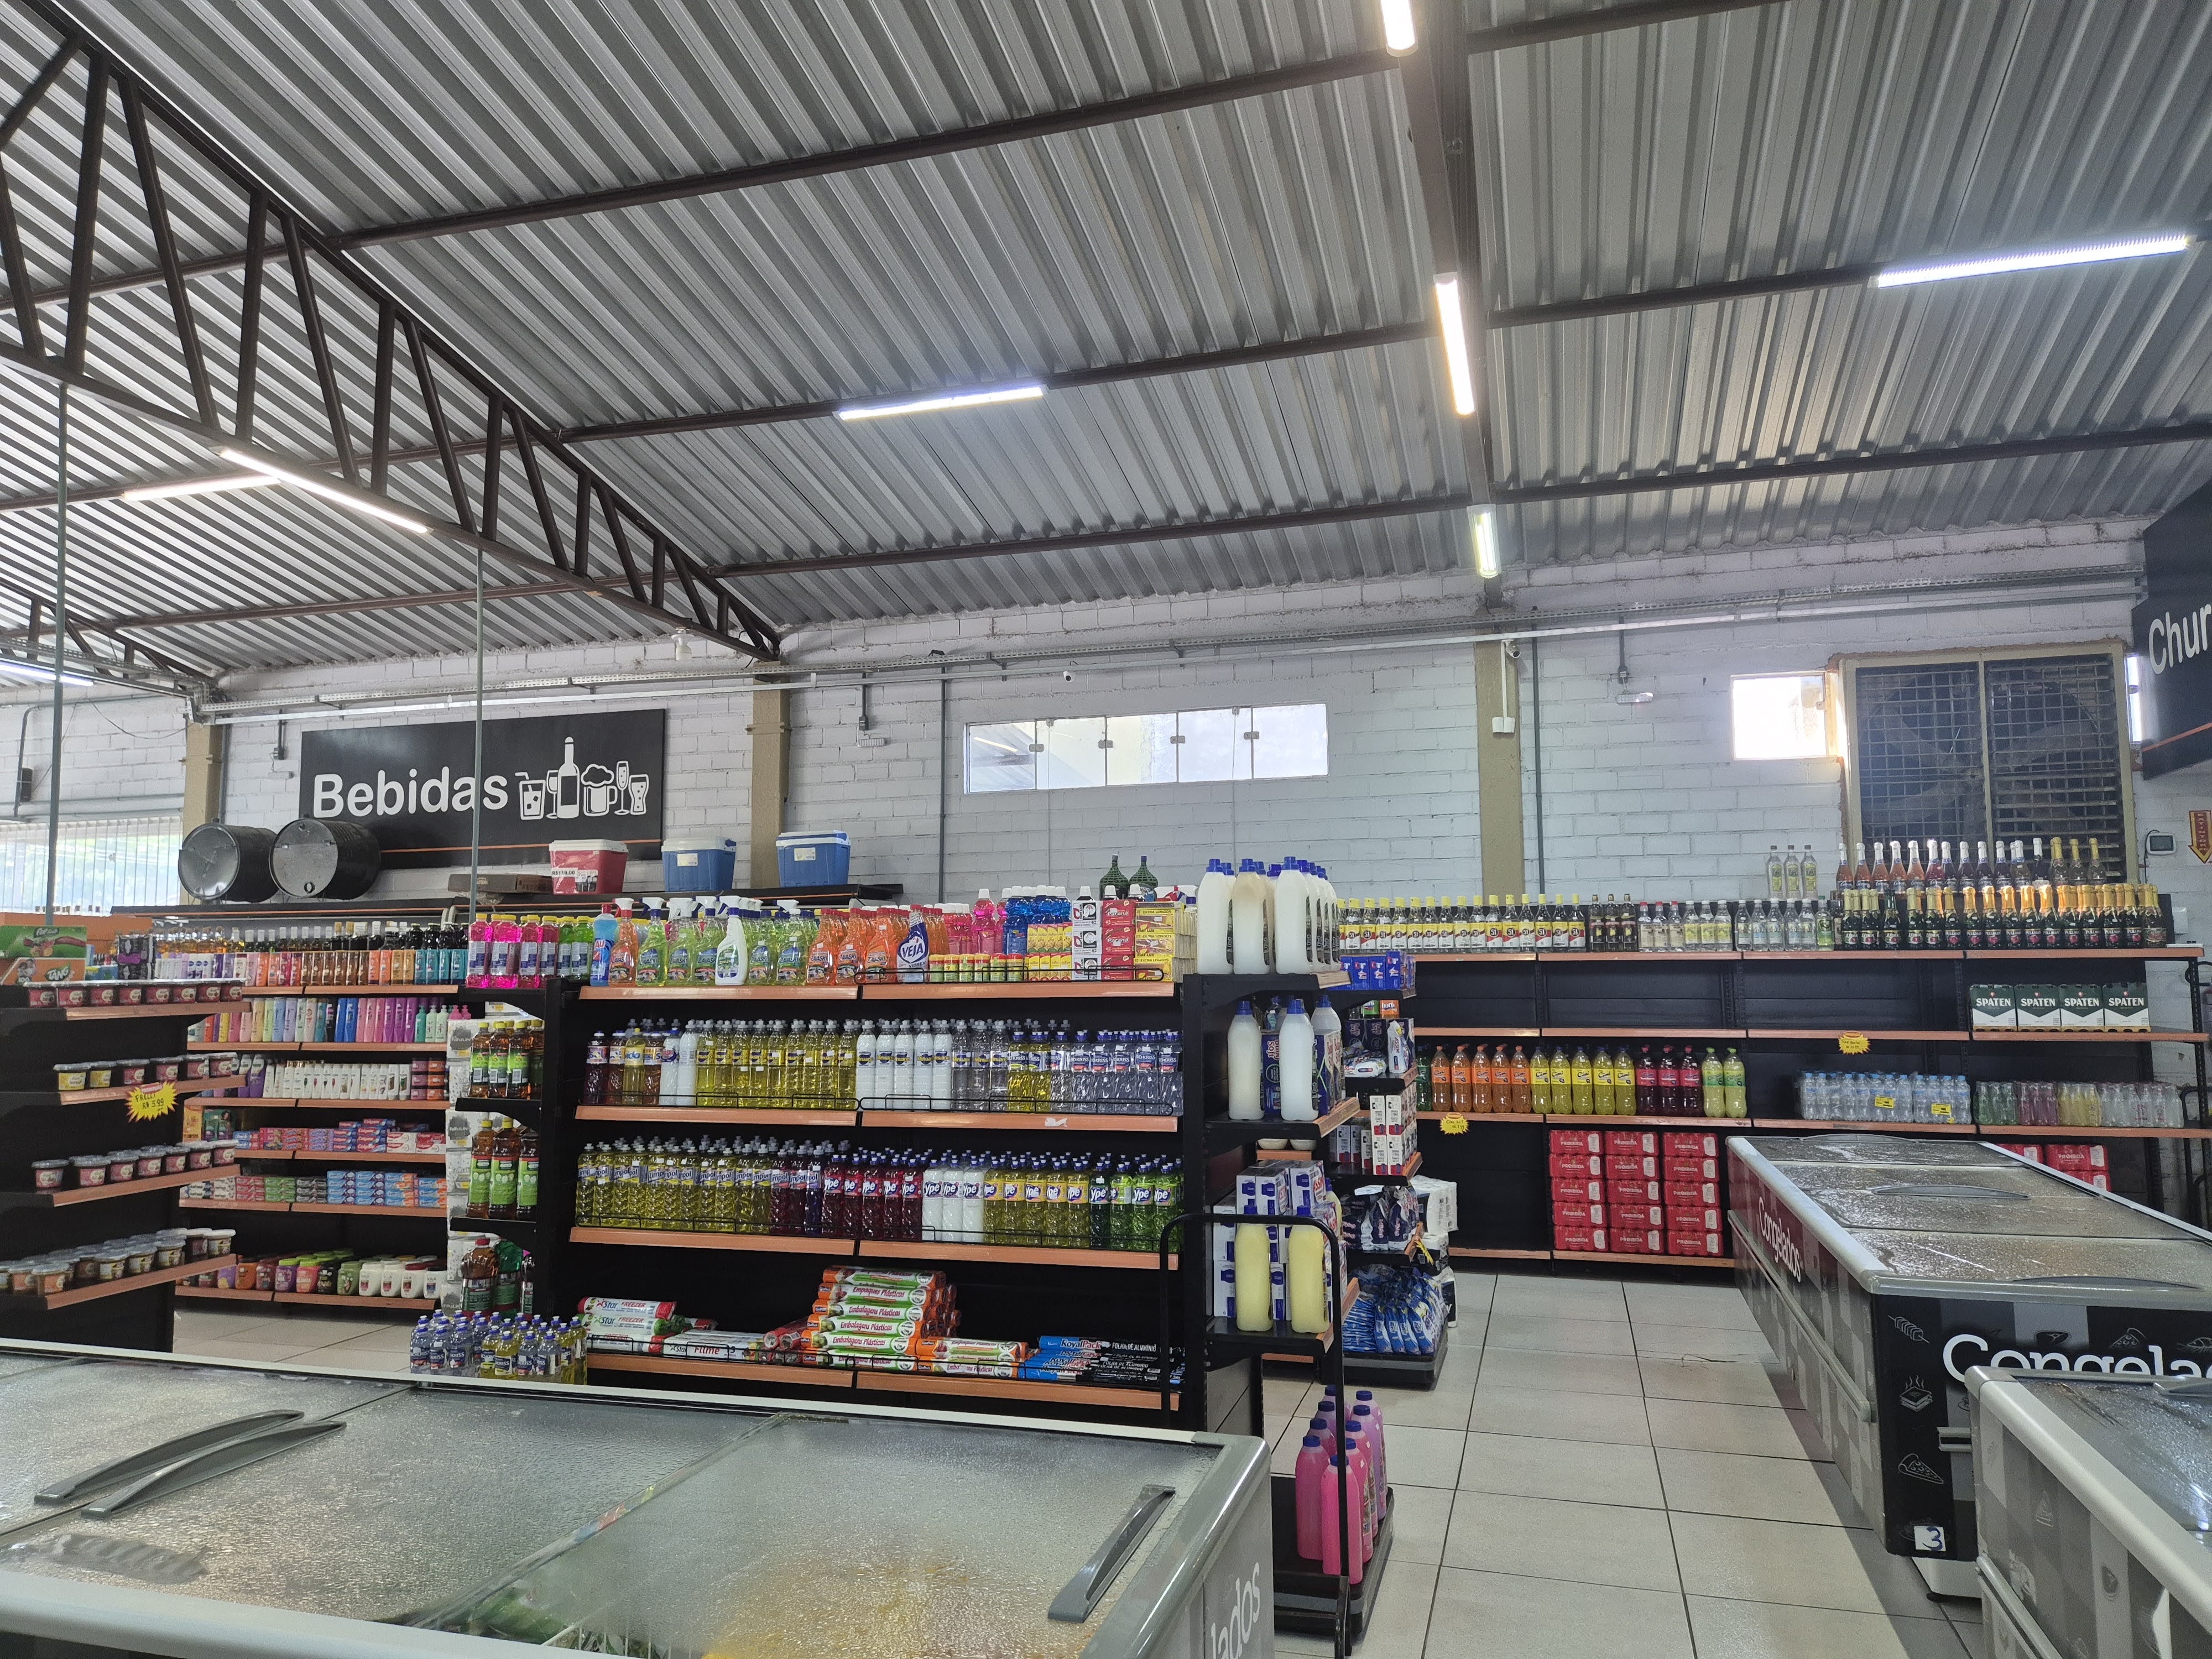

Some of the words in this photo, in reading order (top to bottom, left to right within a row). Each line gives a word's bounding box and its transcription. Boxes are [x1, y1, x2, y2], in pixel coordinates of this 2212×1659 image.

[2149, 604, 2211, 674] Chur
[314, 766, 508, 818] Bebidas
[901, 944, 924, 958] VEJA
[1976, 998, 2011, 1006] SPATEN
[2021, 998, 2056, 1006] SPATEN
[2064, 998, 2099, 1006] SPATEN
[2109, 998, 2144, 1006] SPATEN
[1759, 1197, 1801, 1283] Congelados
[853, 1287, 881, 1296] Empaques
[603, 1301, 618, 1309] Star
[849, 1306, 878, 1315] Embalagens
[841, 1322, 870, 1331] Embalagens
[833, 1337, 863, 1346] Embalagens
[863, 1337, 886, 1345] Plásticas
[1060, 1338, 1102, 1350] RoyalPack
[1922, 1526, 1943, 1551] 3
